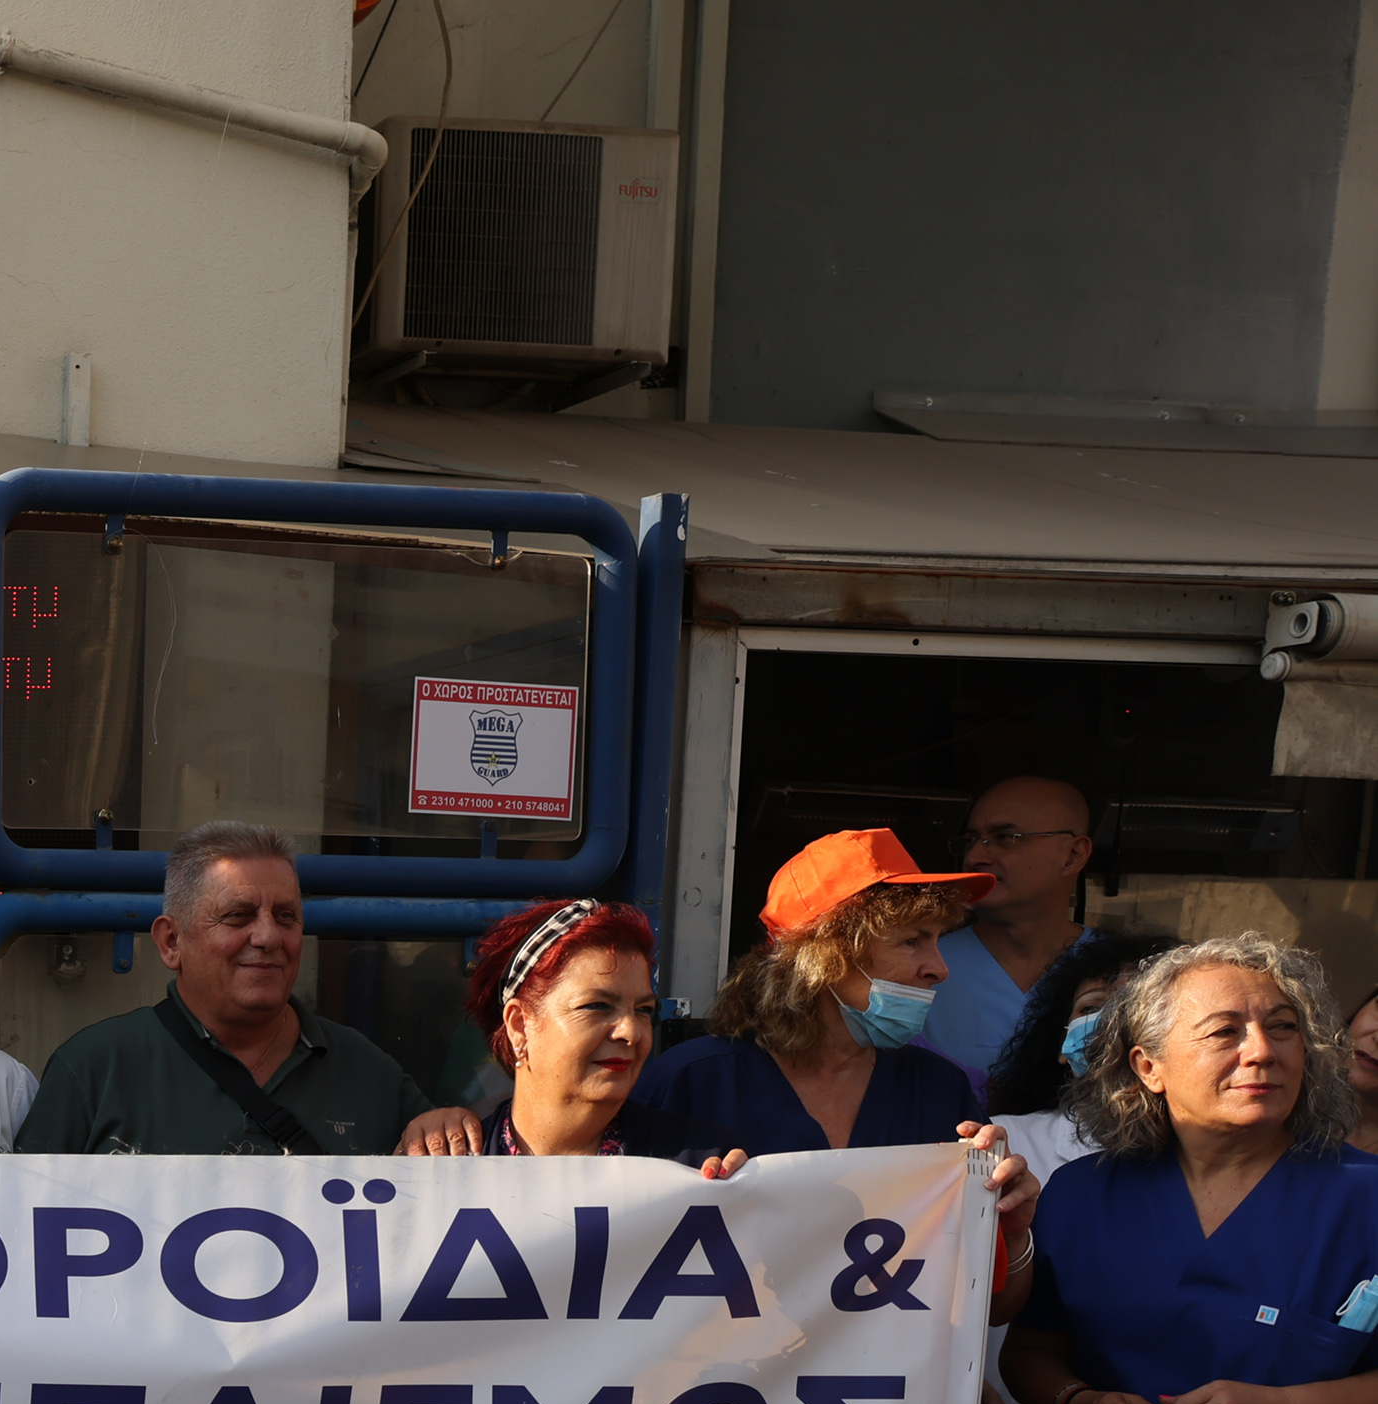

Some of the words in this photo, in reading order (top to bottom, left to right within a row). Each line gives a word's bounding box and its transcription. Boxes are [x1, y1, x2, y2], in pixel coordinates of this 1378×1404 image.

[618, 180, 657, 199] FUJITSU
[421, 682, 431, 698] Ο
[433, 683, 474, 700] ΧΩΡΟΣ
[476, 685, 572, 706] ΠΡΟΣΤΑΤΕΥΕΤΑΙ
[476, 716, 515, 733] MEGA
[477, 766, 509, 778] GUARD
[431, 795, 455, 807] 2310
[458, 796, 494, 809] 471000
[505, 799, 523, 810] 210
[525, 800, 565, 813] 5748041
[830, 1218, 932, 1312] &
